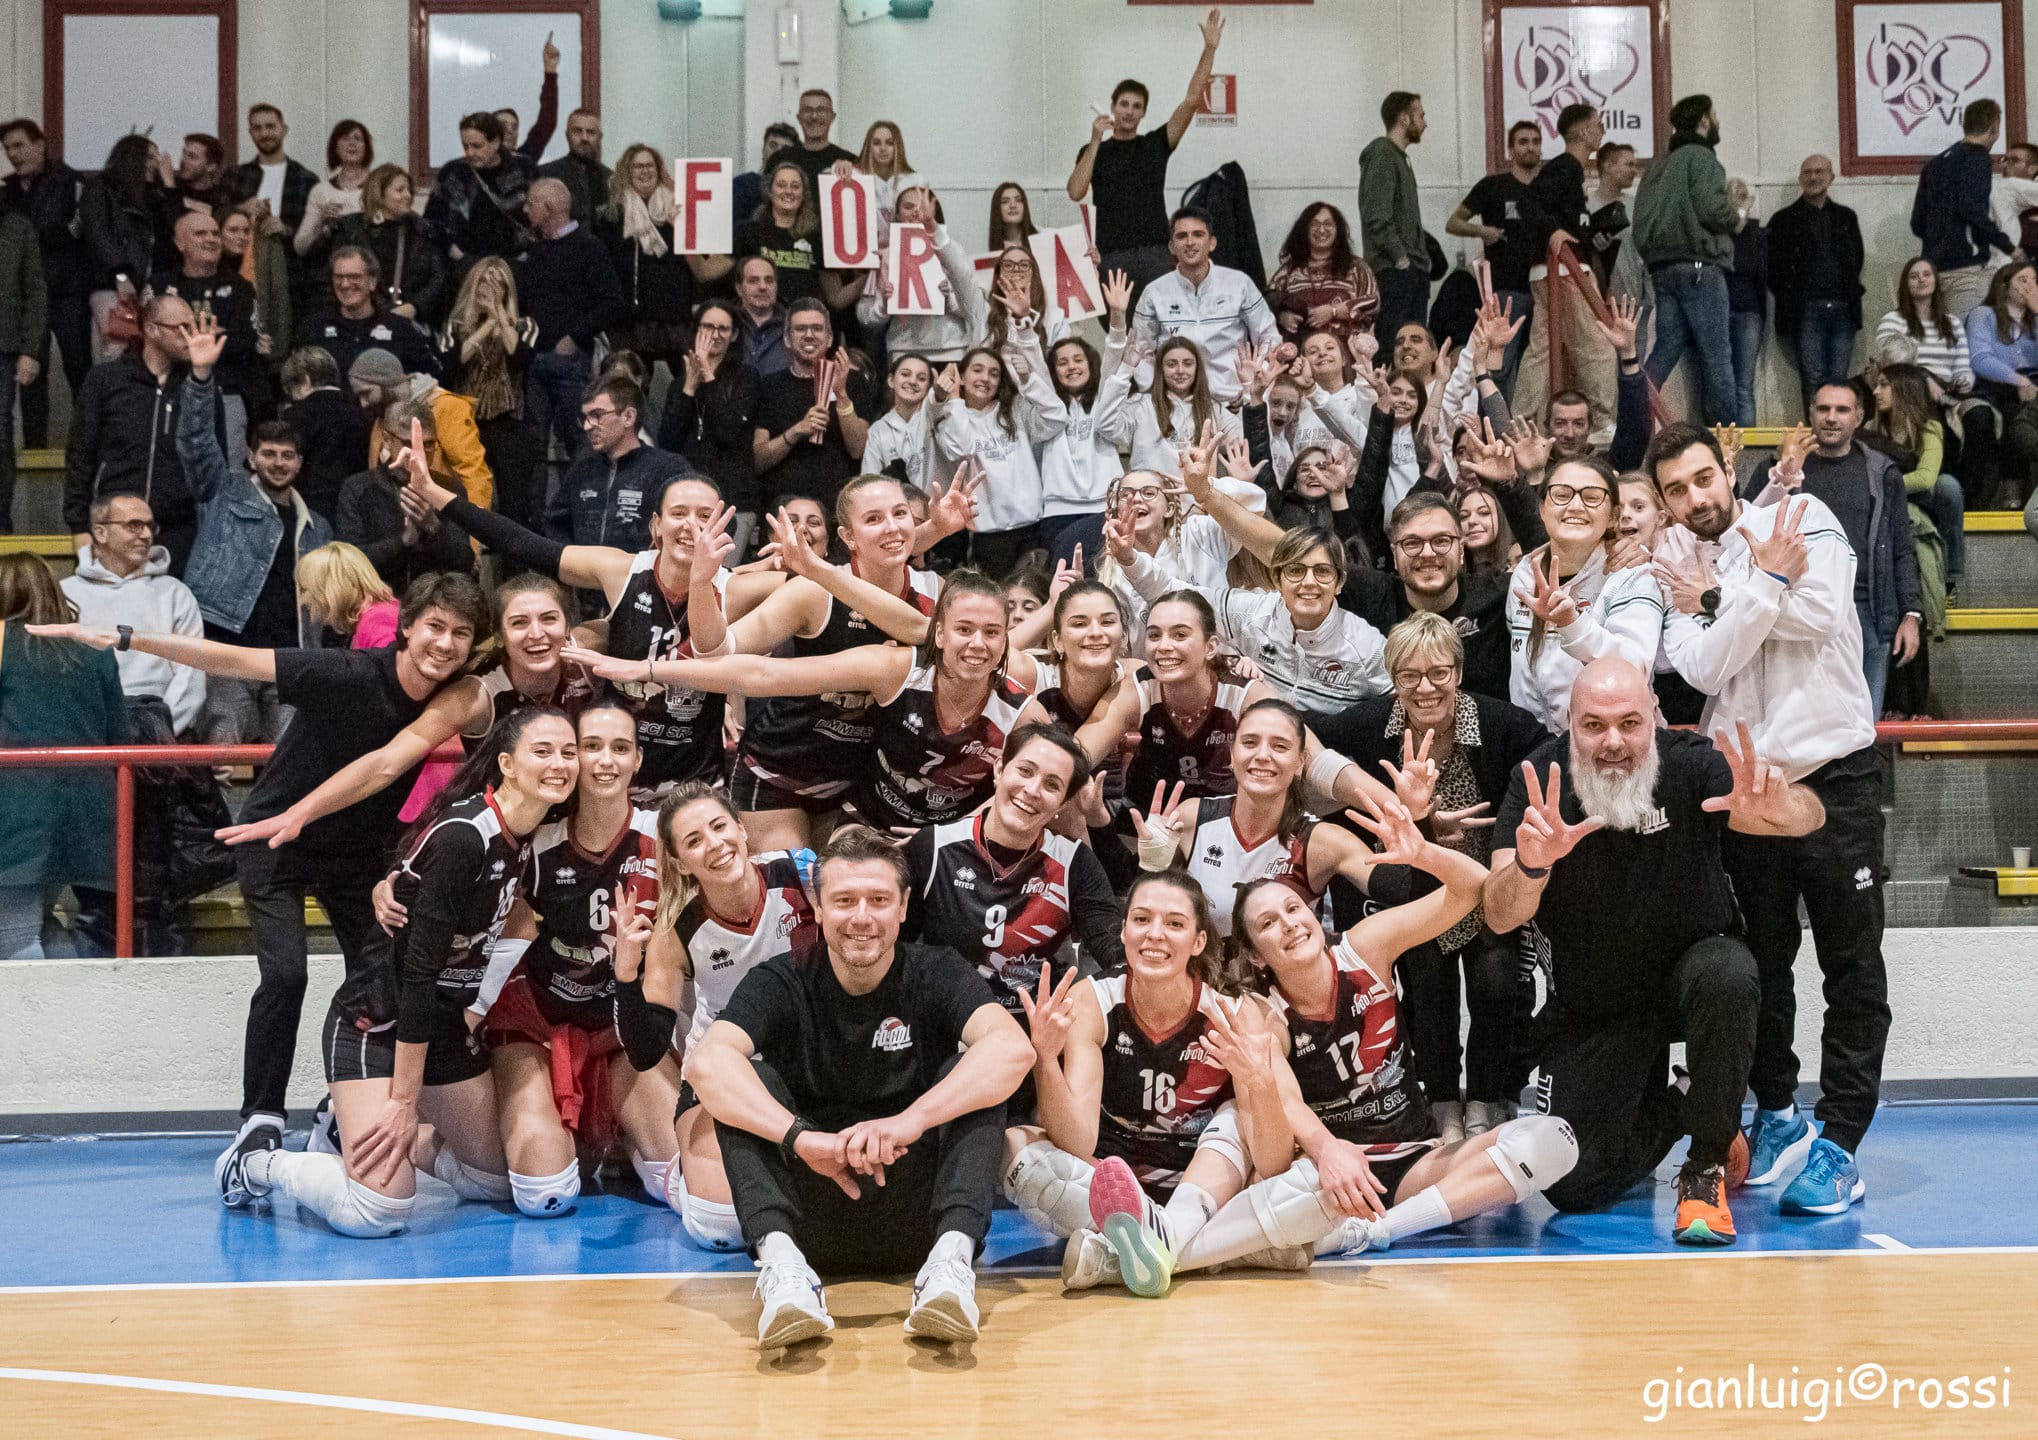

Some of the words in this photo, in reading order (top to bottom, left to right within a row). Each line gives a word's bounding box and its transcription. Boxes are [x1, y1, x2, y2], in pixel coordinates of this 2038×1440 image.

[1600, 110, 1641, 129] illa
[685, 162, 721, 250] F
[898, 227, 932, 309] R
[1055, 233, 1096, 318] A
[919, 750, 945, 775] 7
[1179, 756, 1199, 779] 8
[589, 888, 610, 931] 6
[982, 904, 1008, 948] 9
[1325, 1031, 1364, 1082] 17
[1139, 1069, 1176, 1114] 16
